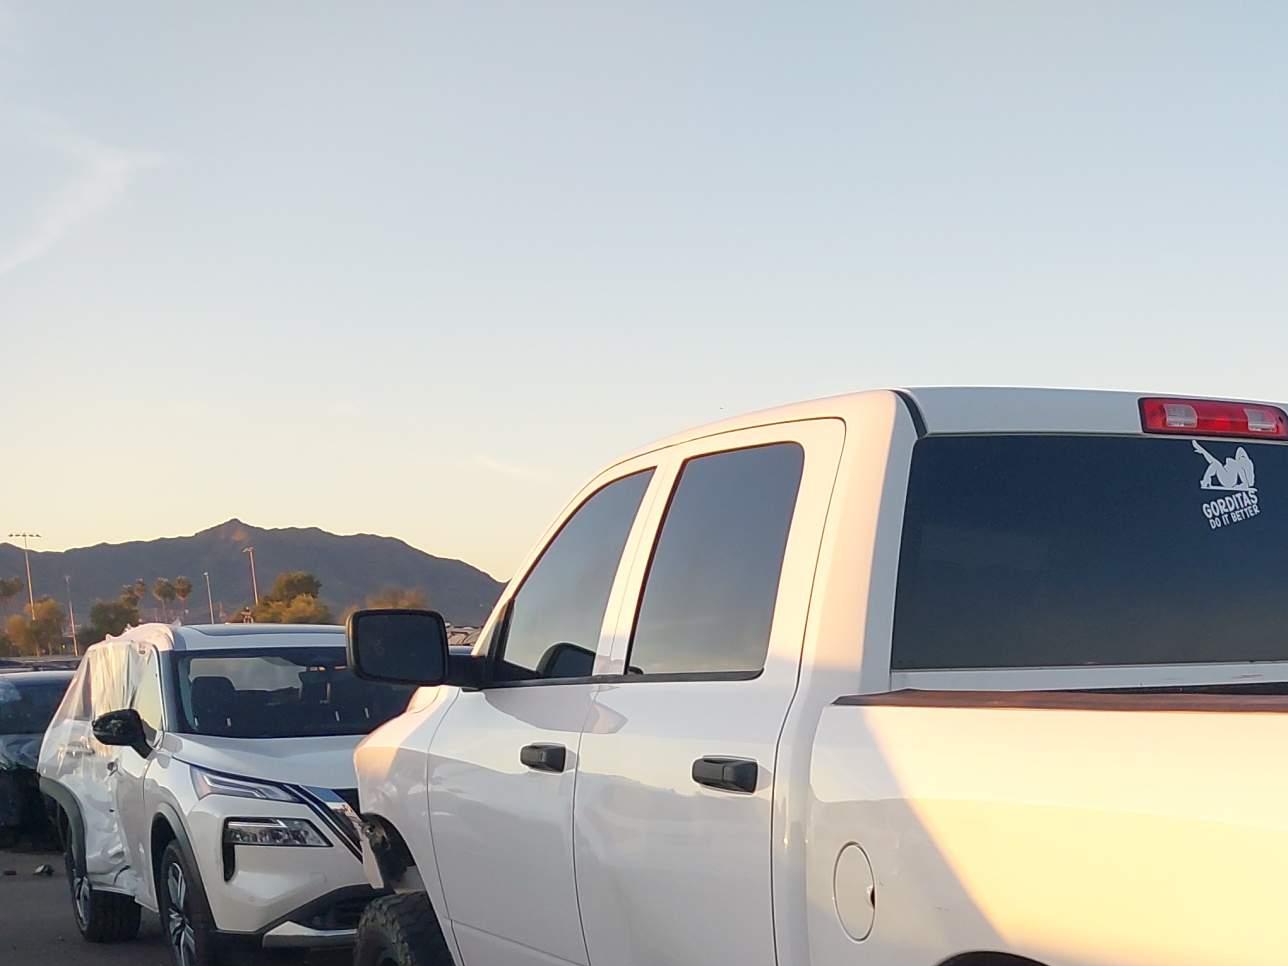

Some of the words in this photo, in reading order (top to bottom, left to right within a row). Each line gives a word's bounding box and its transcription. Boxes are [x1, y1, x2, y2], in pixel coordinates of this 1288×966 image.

[1202, 490, 1258, 519] GORDITAS
[1209, 517, 1222, 529] DO
[1222, 514, 1230, 526] IT
[1230, 504, 1260, 522] BETTER
